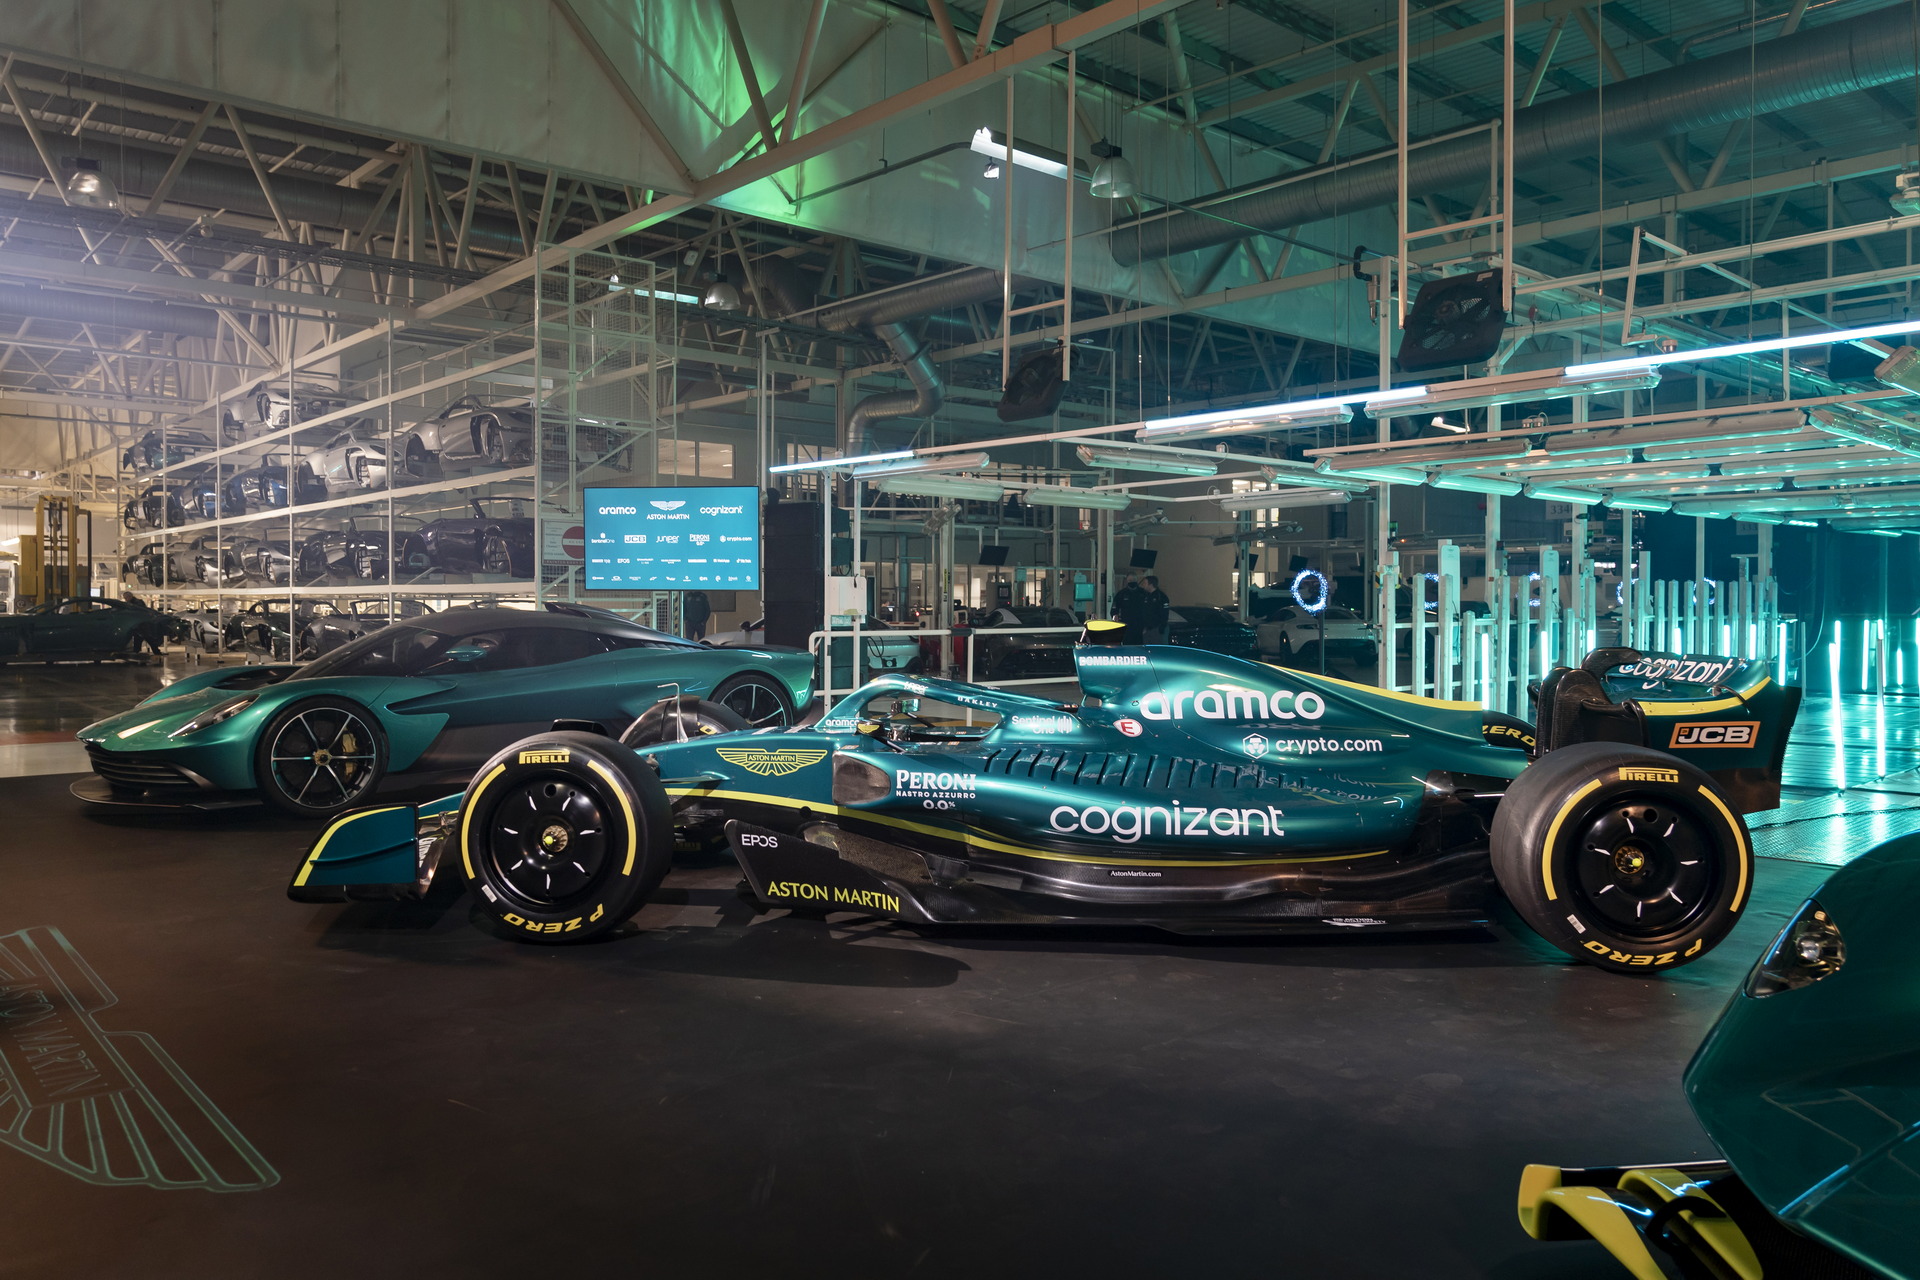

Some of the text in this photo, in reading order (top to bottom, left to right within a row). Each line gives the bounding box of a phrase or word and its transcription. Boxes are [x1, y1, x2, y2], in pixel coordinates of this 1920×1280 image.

[598, 506, 637, 515] aramco
[699, 505, 743, 517] cognizant
[1078, 655, 1147, 666] BOMBARDIER
[957, 696, 998, 708] OAKLEY
[1139, 690, 1325, 720] aramco
[1011, 715, 1055, 725] Sentinel
[1121, 721, 1135, 735] E
[1678, 727, 1750, 743] JCB
[1275, 737, 1383, 754] crypto.com
[518, 749, 570, 765] PIRELLI
[747, 754, 796, 762] ASTON MARTIN
[896, 769, 976, 790] PERONI
[1618, 767, 1679, 783] PIRELLI
[896, 790, 930, 798] NASTRO
[923, 800, 955, 810] 0.0%
[1049, 800, 1285, 844] cognizant
[741, 834, 778, 848] EPOS
[1110, 870, 1162, 878] AstonMartin.com
[767, 881, 900, 913] ASTON MARTIN
[503, 903, 605, 934] P ZERO
[1583, 938, 1702, 966] P ZERO
